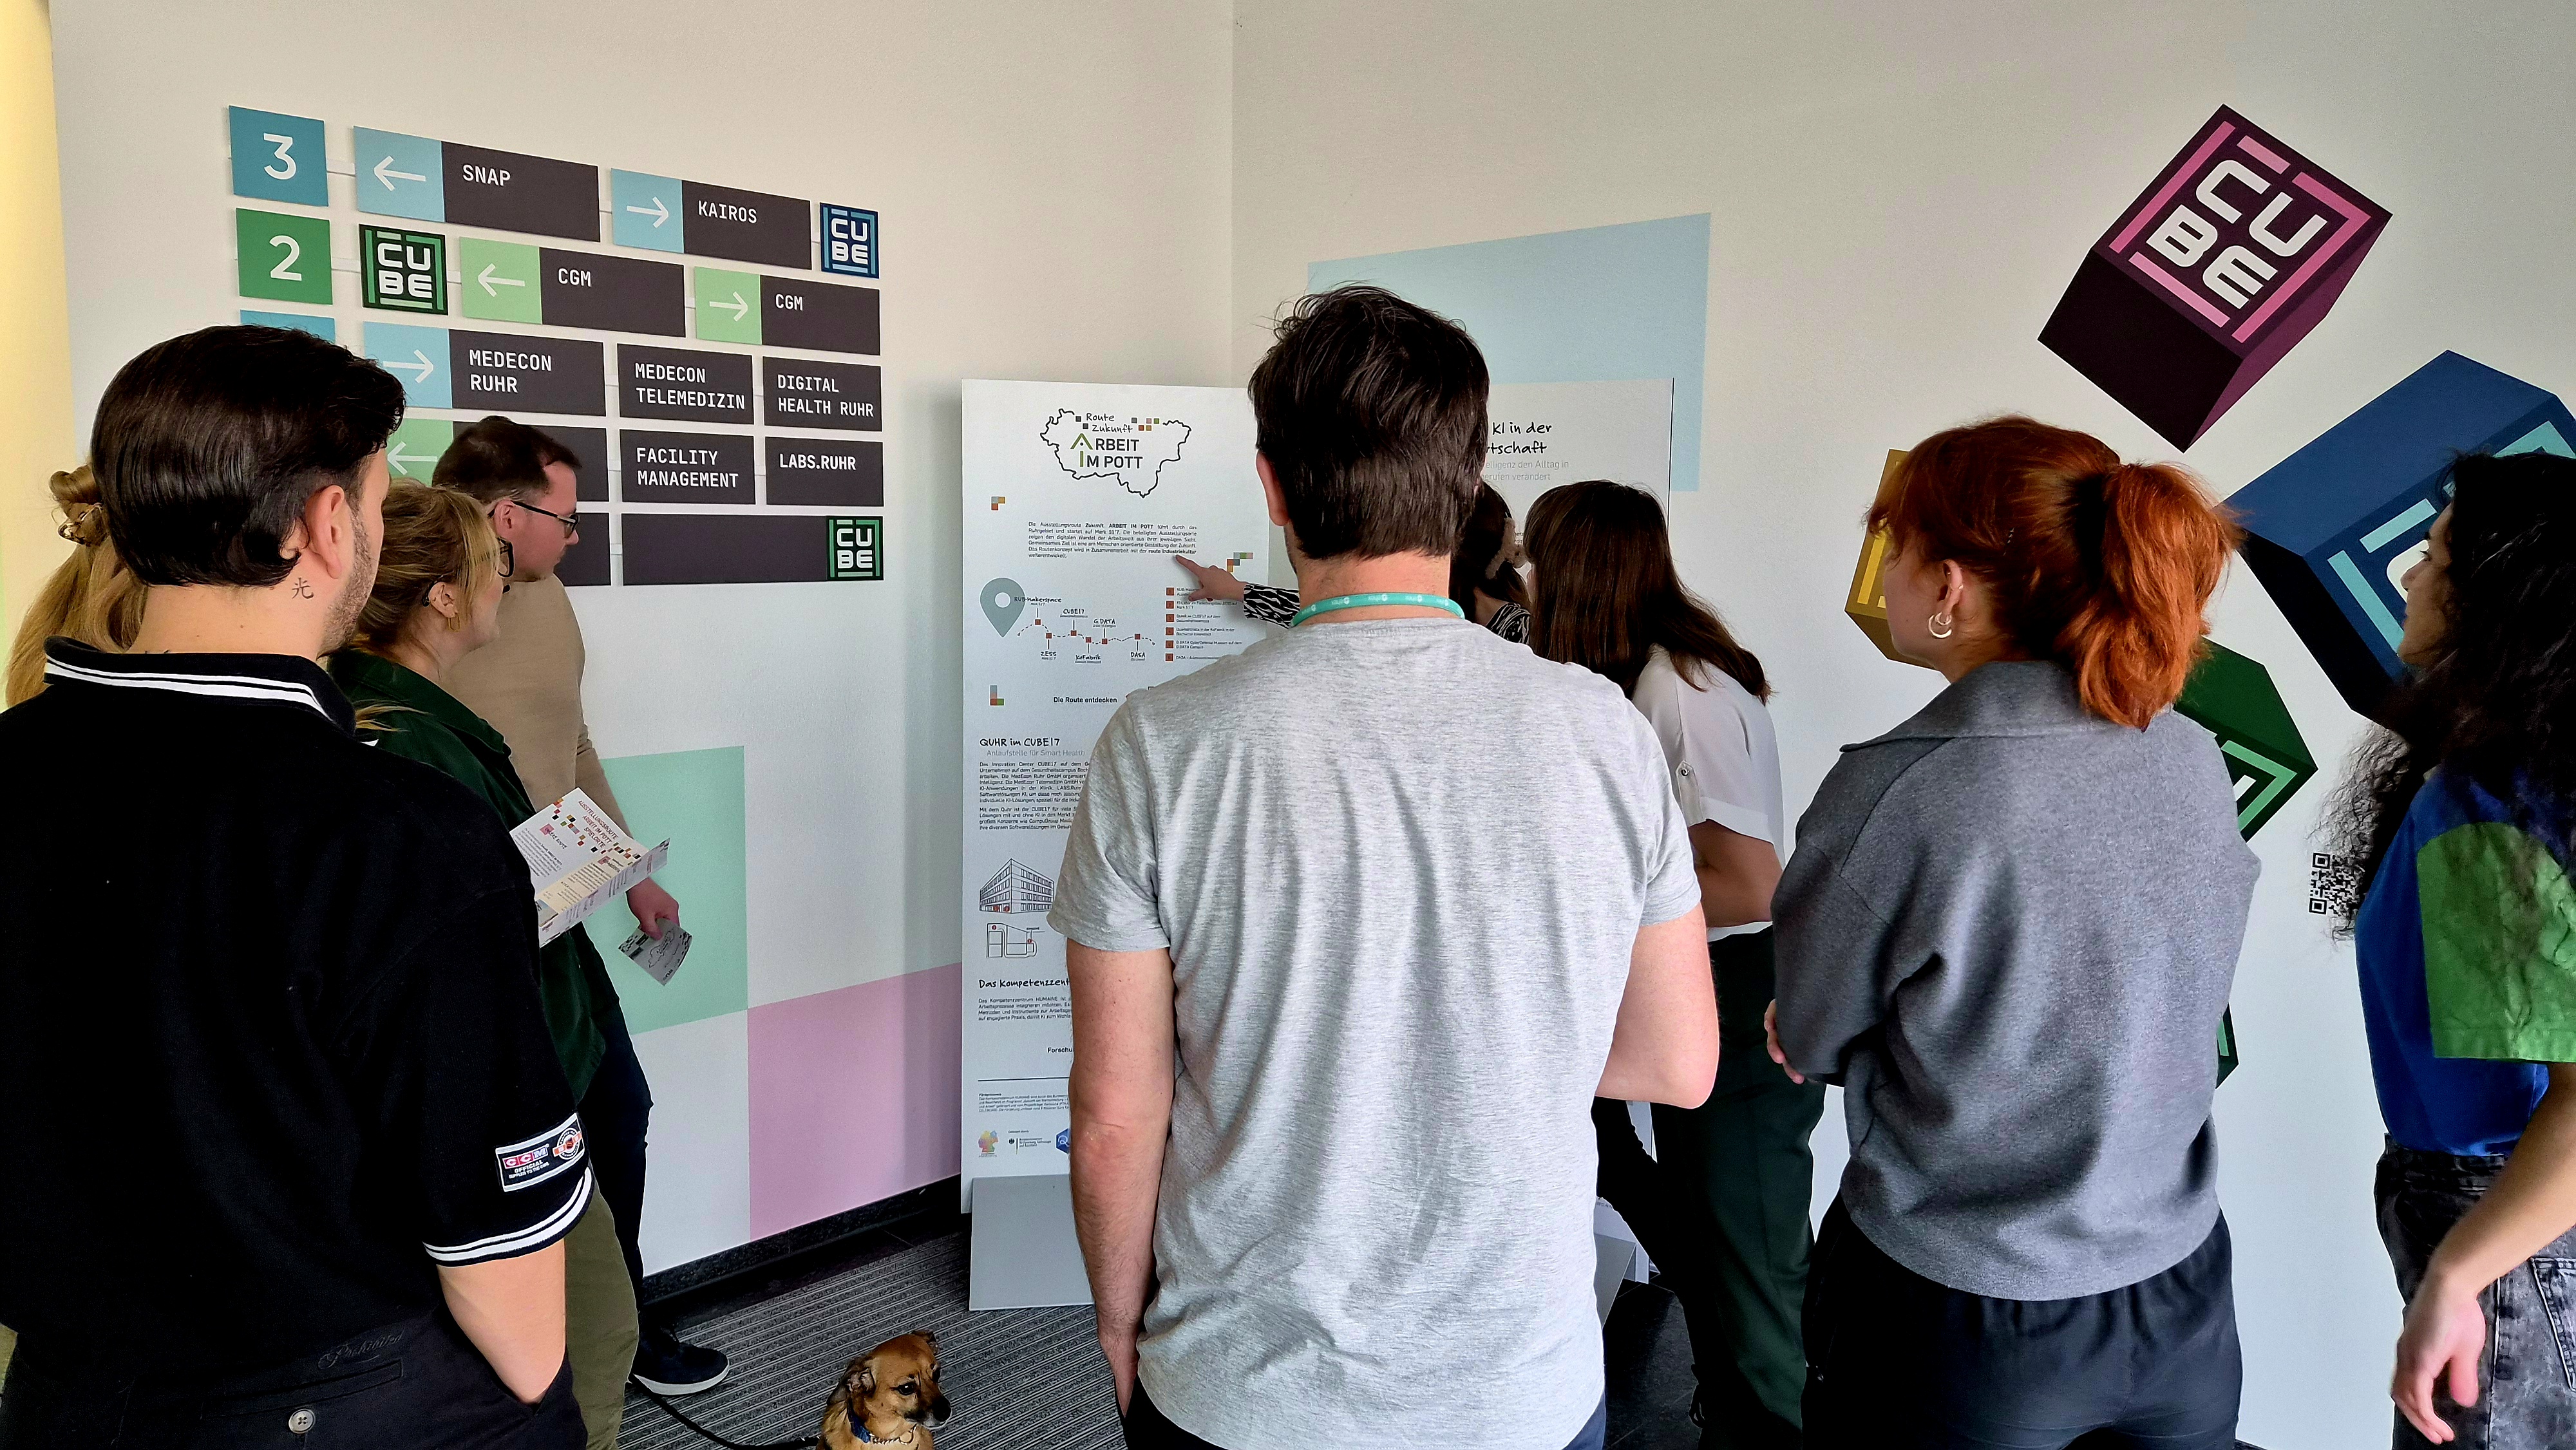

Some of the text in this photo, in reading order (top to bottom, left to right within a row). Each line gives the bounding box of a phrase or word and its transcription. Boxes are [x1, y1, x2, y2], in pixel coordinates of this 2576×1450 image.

[263, 133, 297, 180] 3
[462, 164, 511, 187] SNAP
[697, 200, 758, 223] KAIROS
[269, 234, 302, 281] 2
[557, 267, 592, 287] CGM
[775, 293, 804, 311] CGM
[468, 348, 552, 372] MEDECON
[634, 362, 706, 384] MEDECON
[469, 373, 518, 395] RUHR
[777, 373, 840, 393] DIGITAL
[636, 387, 745, 410] TELEMEDIZIN
[778, 397, 874, 418] HEALTH RUHR
[1086, 413, 1115, 422] Route
[1092, 424, 1133, 433] Zukunft
[1492, 421, 1552, 435] KI in der
[1070, 433, 1140, 451] ARBEIT
[1486, 440, 1548, 455] rtschaft
[636, 447, 718, 466] FACILITY
[779, 453, 857, 471] LABS.RUHR
[1079, 451, 1143, 469] IM POTT
[1486, 460, 1569, 470] elligenz den Alltag in
[637, 470, 739, 489] MANAGEMENT
[291, 577, 314, 599] 光
[980, 738, 1007, 747] QUHR
[1010, 738, 1021, 746] im
[978, 978, 1070, 989] Das Kompetenzzent
[505, 1146, 547, 1167] CCM
[514, 1160, 544, 1174] OFFICIAL
